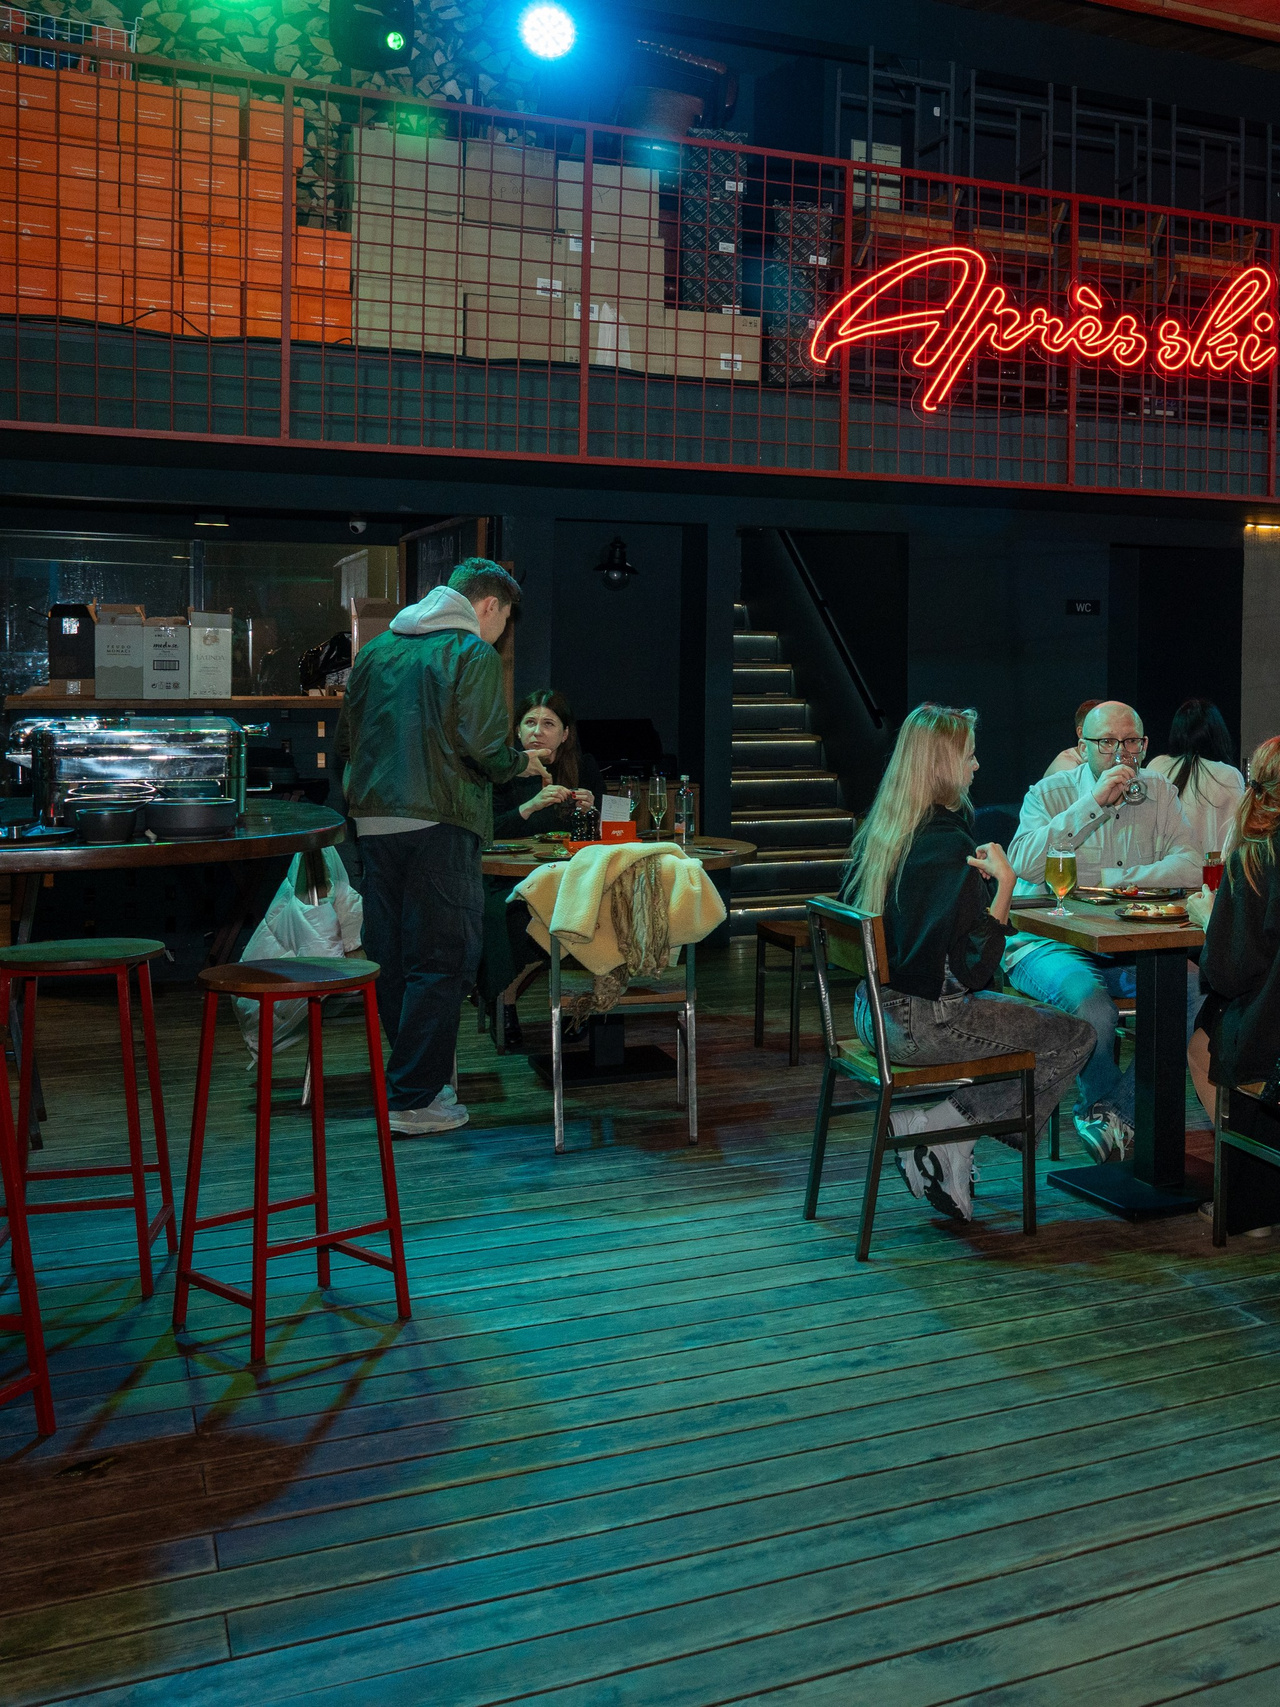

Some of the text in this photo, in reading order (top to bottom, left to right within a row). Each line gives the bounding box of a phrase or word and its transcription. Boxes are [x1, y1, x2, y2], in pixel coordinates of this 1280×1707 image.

[810, 246, 1277, 411] Après ski
[1075, 602, 1092, 613] WC
